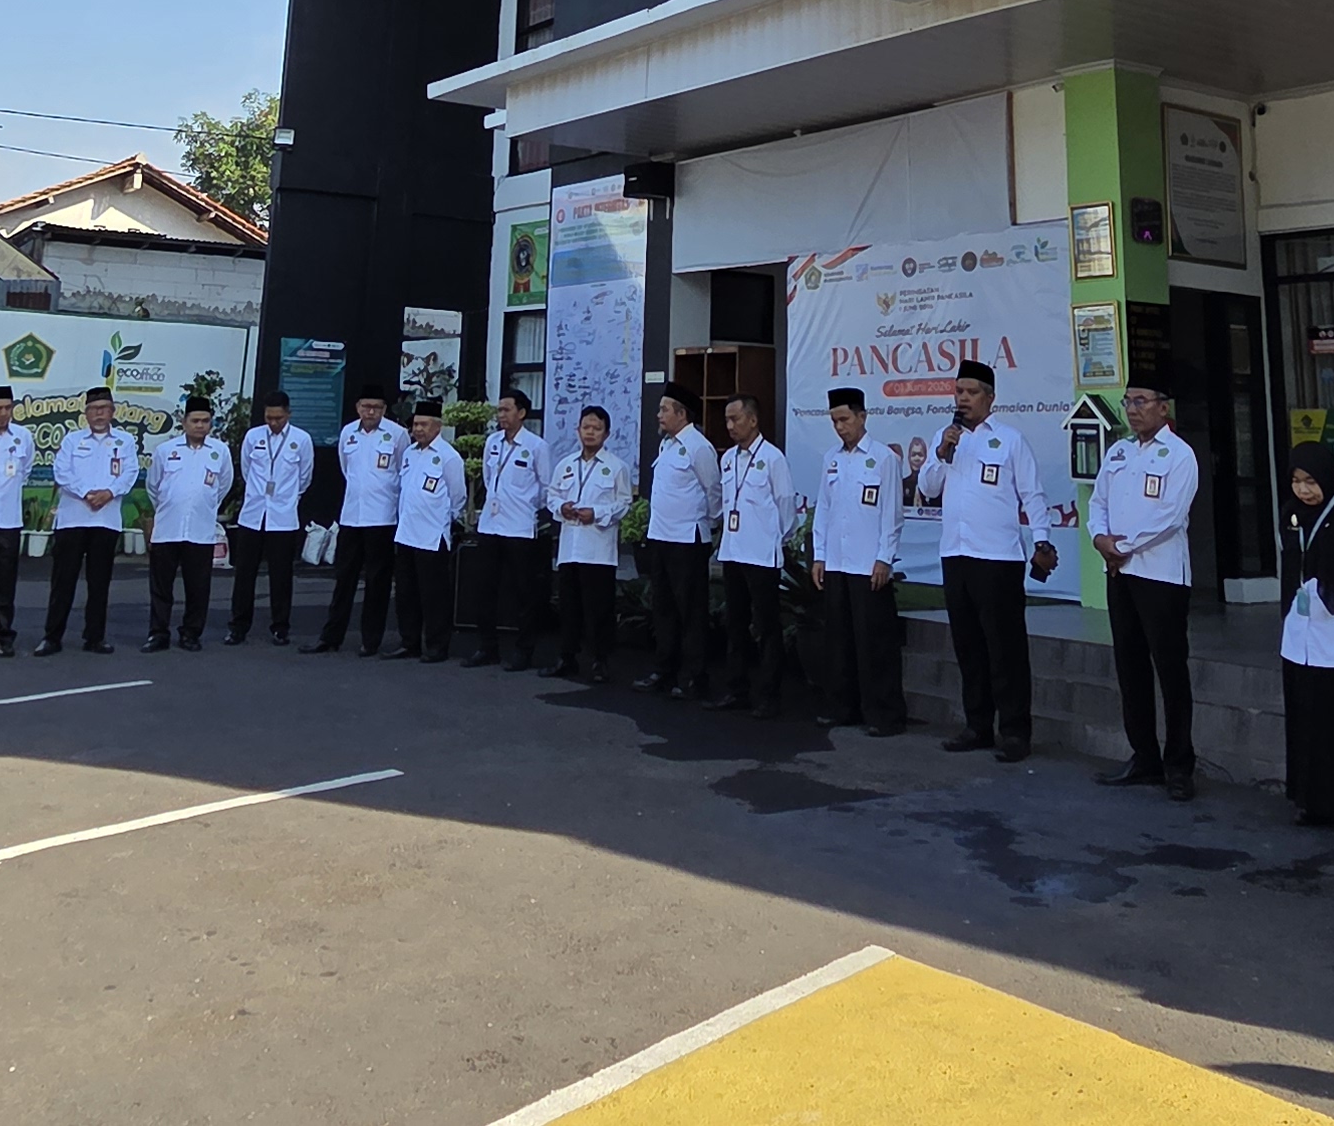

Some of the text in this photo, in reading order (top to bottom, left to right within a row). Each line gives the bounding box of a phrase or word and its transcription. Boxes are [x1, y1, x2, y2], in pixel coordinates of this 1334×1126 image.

[875, 318, 972, 338] Selamat Hari Lahir
[830, 335, 1018, 377] PANCASILA
[927, 380, 952, 392] 2026
[12, 391, 167, 433] elamat atang
[887, 405, 924, 418] Bangsa,
